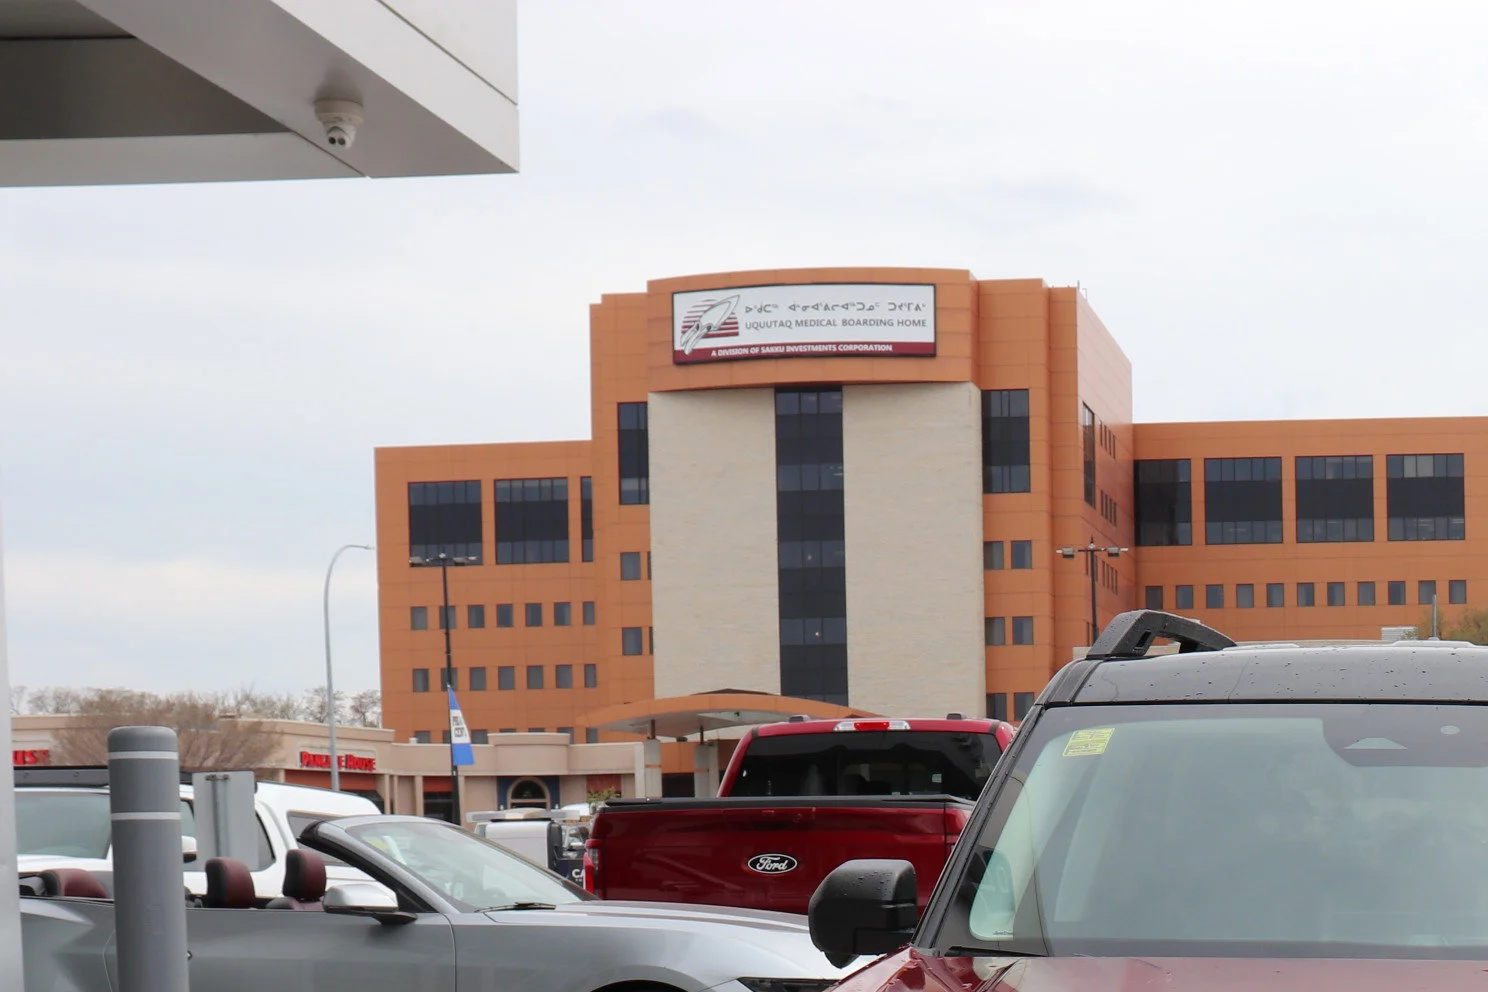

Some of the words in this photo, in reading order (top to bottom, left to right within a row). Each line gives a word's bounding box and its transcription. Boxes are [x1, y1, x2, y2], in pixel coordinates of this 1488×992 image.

[745, 319, 793, 331] UQUUTAQ
[795, 318, 838, 328] MEDICAL
[841, 318, 894, 327] BOARDING
[897, 319, 928, 327] HOME
[711, 349, 718, 357] A
[718, 348, 749, 357] DIVISION
[750, 346, 761, 354] OF
[786, 344, 837, 352] INVESTMENTS
[838, 344, 893, 352] CORPORATION
[345, 753, 376, 771] HOUSE
[756, 856, 788, 871] Ford
